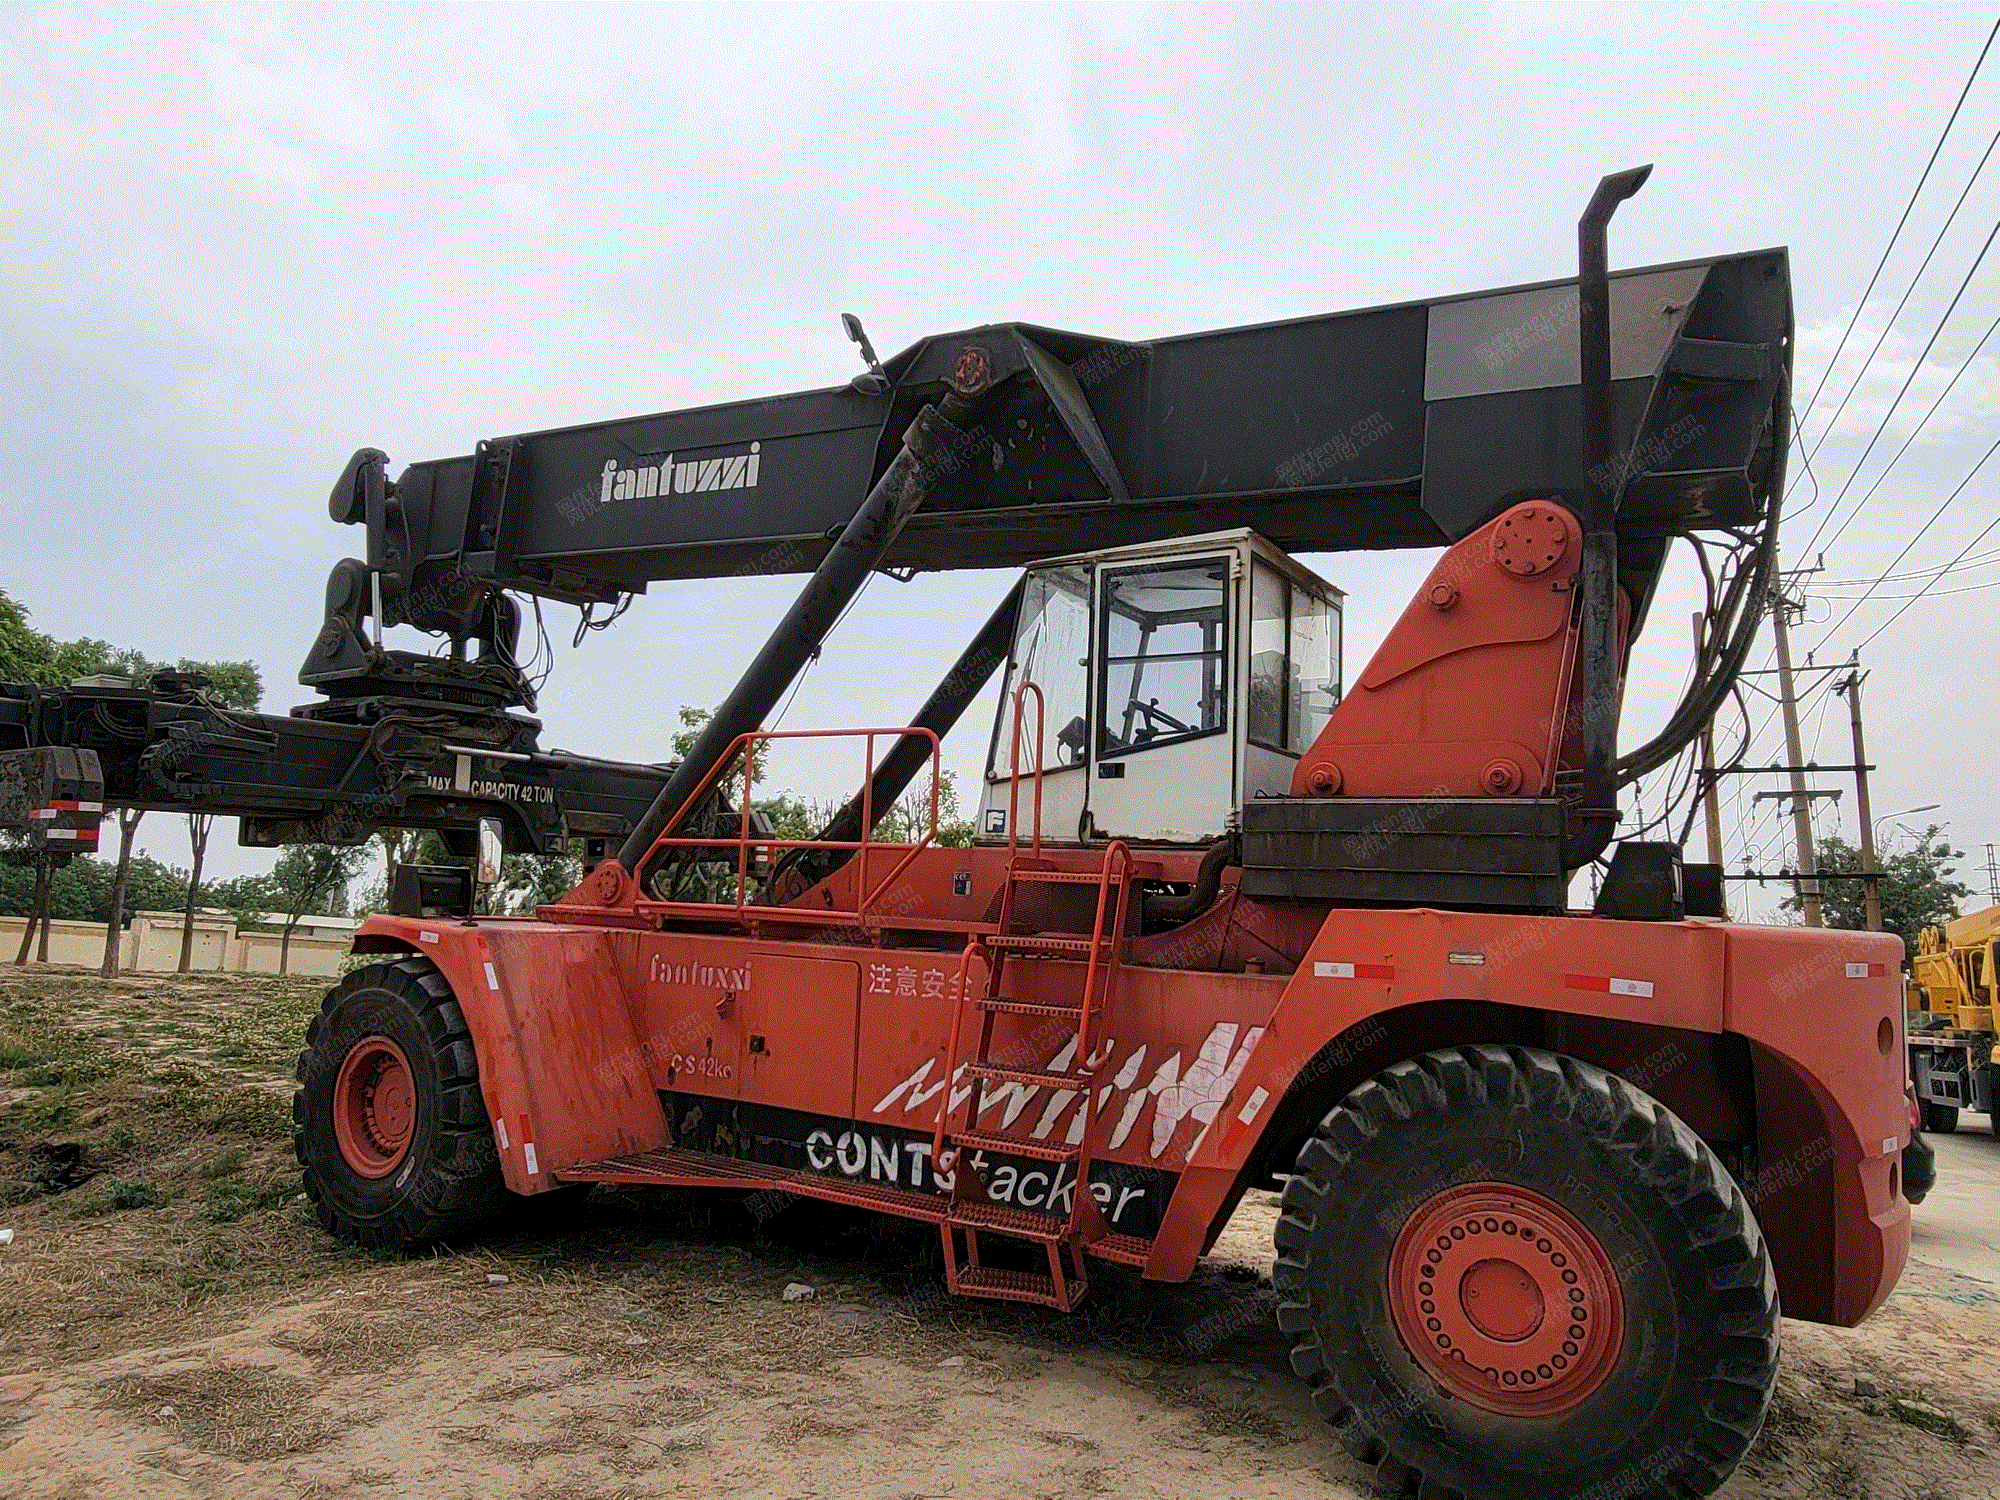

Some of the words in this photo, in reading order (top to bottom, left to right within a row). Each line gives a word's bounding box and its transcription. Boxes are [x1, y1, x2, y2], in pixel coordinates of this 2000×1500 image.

[600, 440, 761, 502] fantuzzi
[471, 780, 521, 801] CAPACITY
[521, 785, 533, 802] 42
[534, 786, 554, 804] TON
[868, 962, 973, 1000] 注意安全
